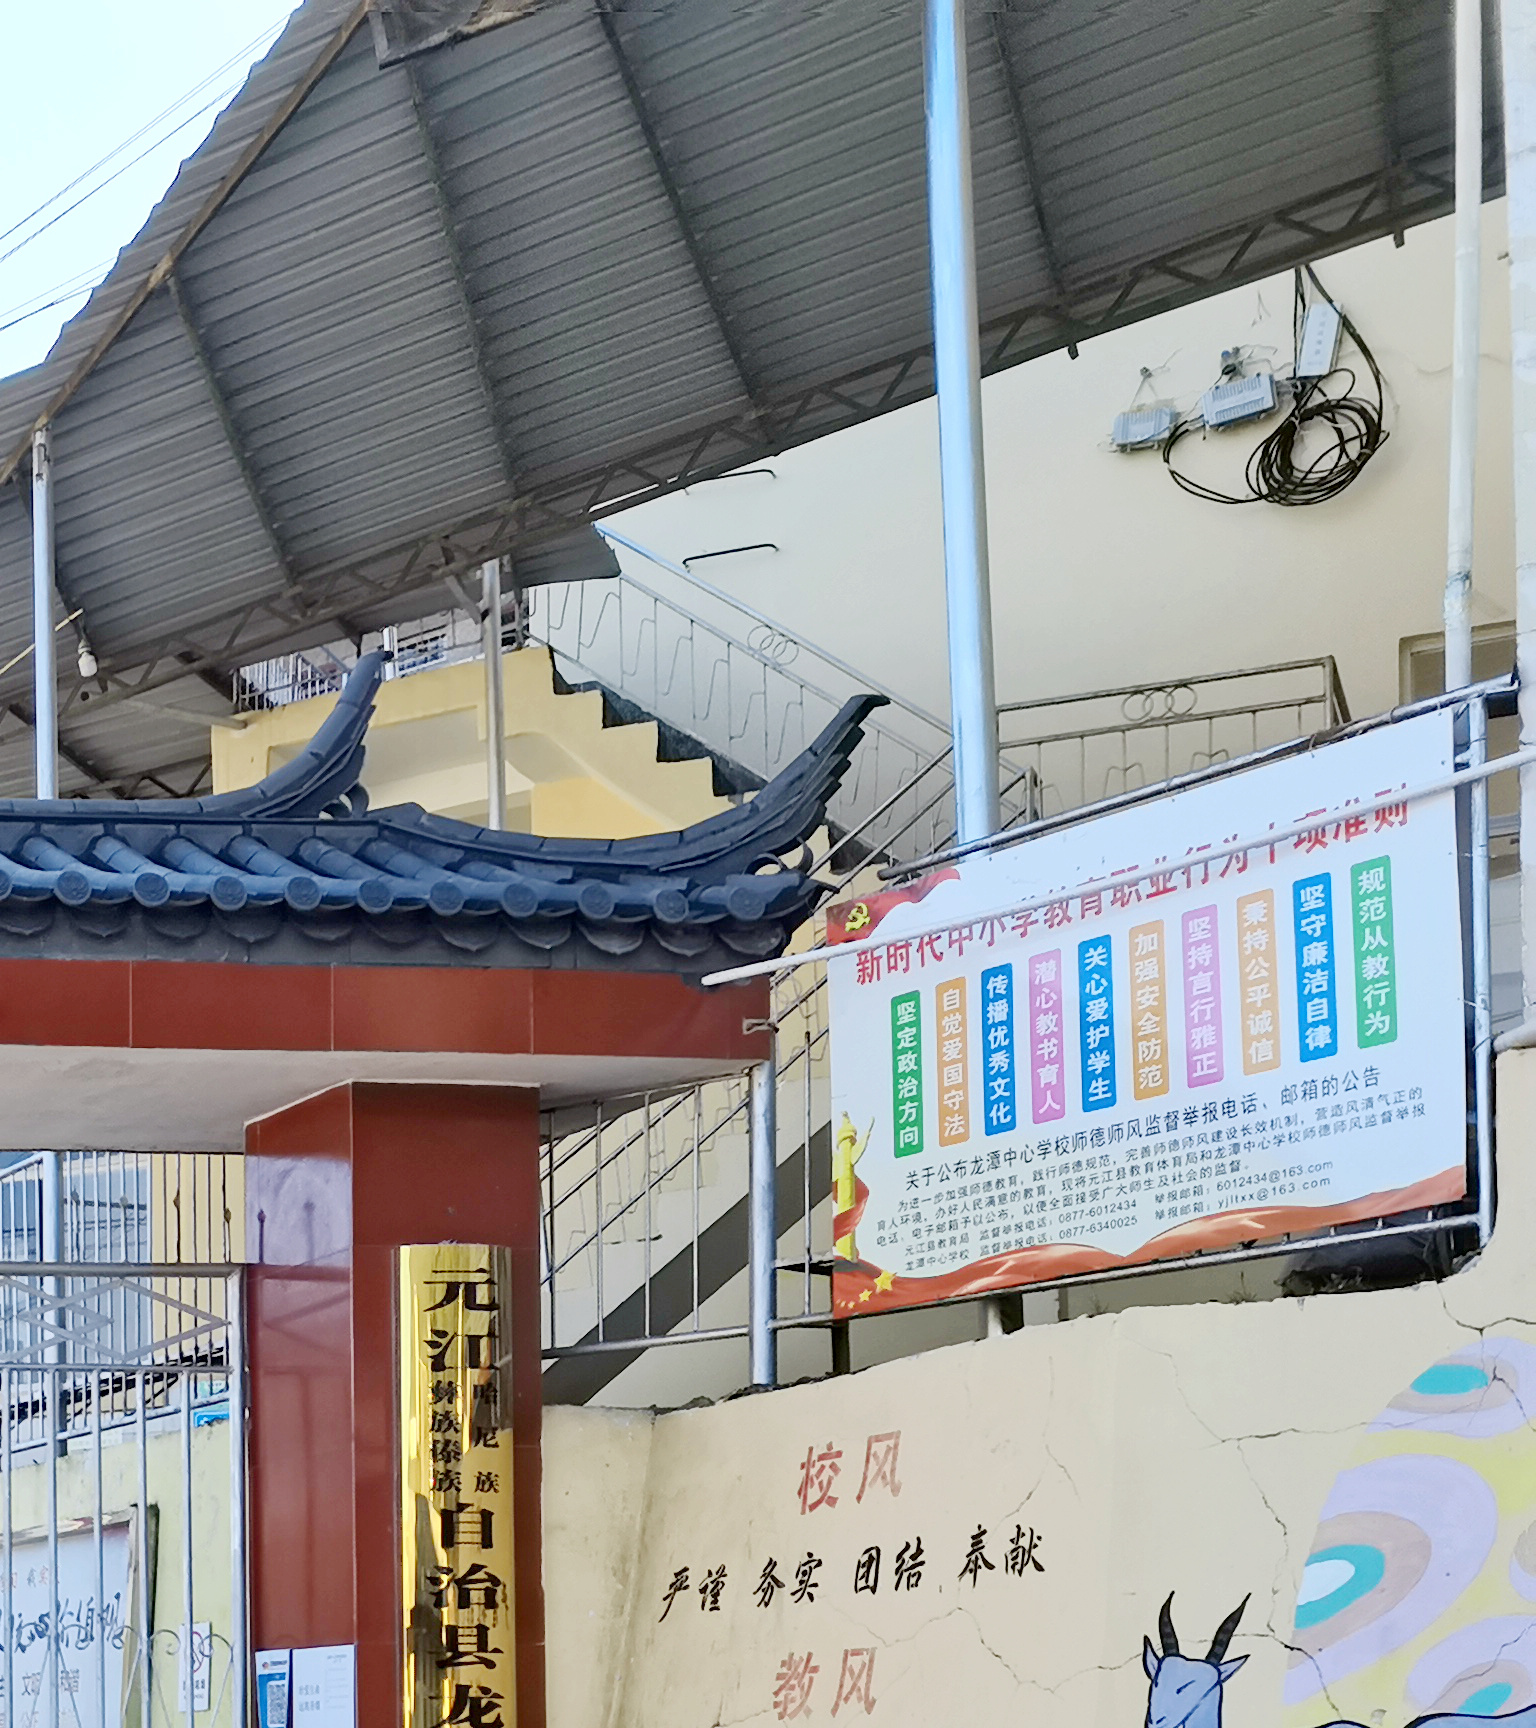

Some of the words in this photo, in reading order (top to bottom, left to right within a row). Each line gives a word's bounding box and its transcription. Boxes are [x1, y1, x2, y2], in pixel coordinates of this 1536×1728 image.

[1084, 944, 1112, 1102] 关心爱护学生
[1134, 932, 1163, 1090] 加强安全防范
[1188, 916, 1218, 1077] 坚持言行雅正
[1242, 900, 1274, 1064] 秉持公平诚信
[1299, 884, 1332, 1051] 坚守廉洁自律
[1358, 867, 1391, 1036] 规范从教行为
[896, 1000, 919, 1149] 坚定政治方向
[941, 988, 965, 1138] 自觉爱国守法
[986, 974, 1012, 1126] 传播优秀文化
[1034, 959, 1061, 1115] 潜心教书育人
[797, 1429, 903, 1516] 校风
[751, 1550, 823, 1609] 务实
[853, 1536, 926, 1595] 团结
[957, 1523, 1046, 1587] 奉献
[770, 1646, 878, 1722] 教风
